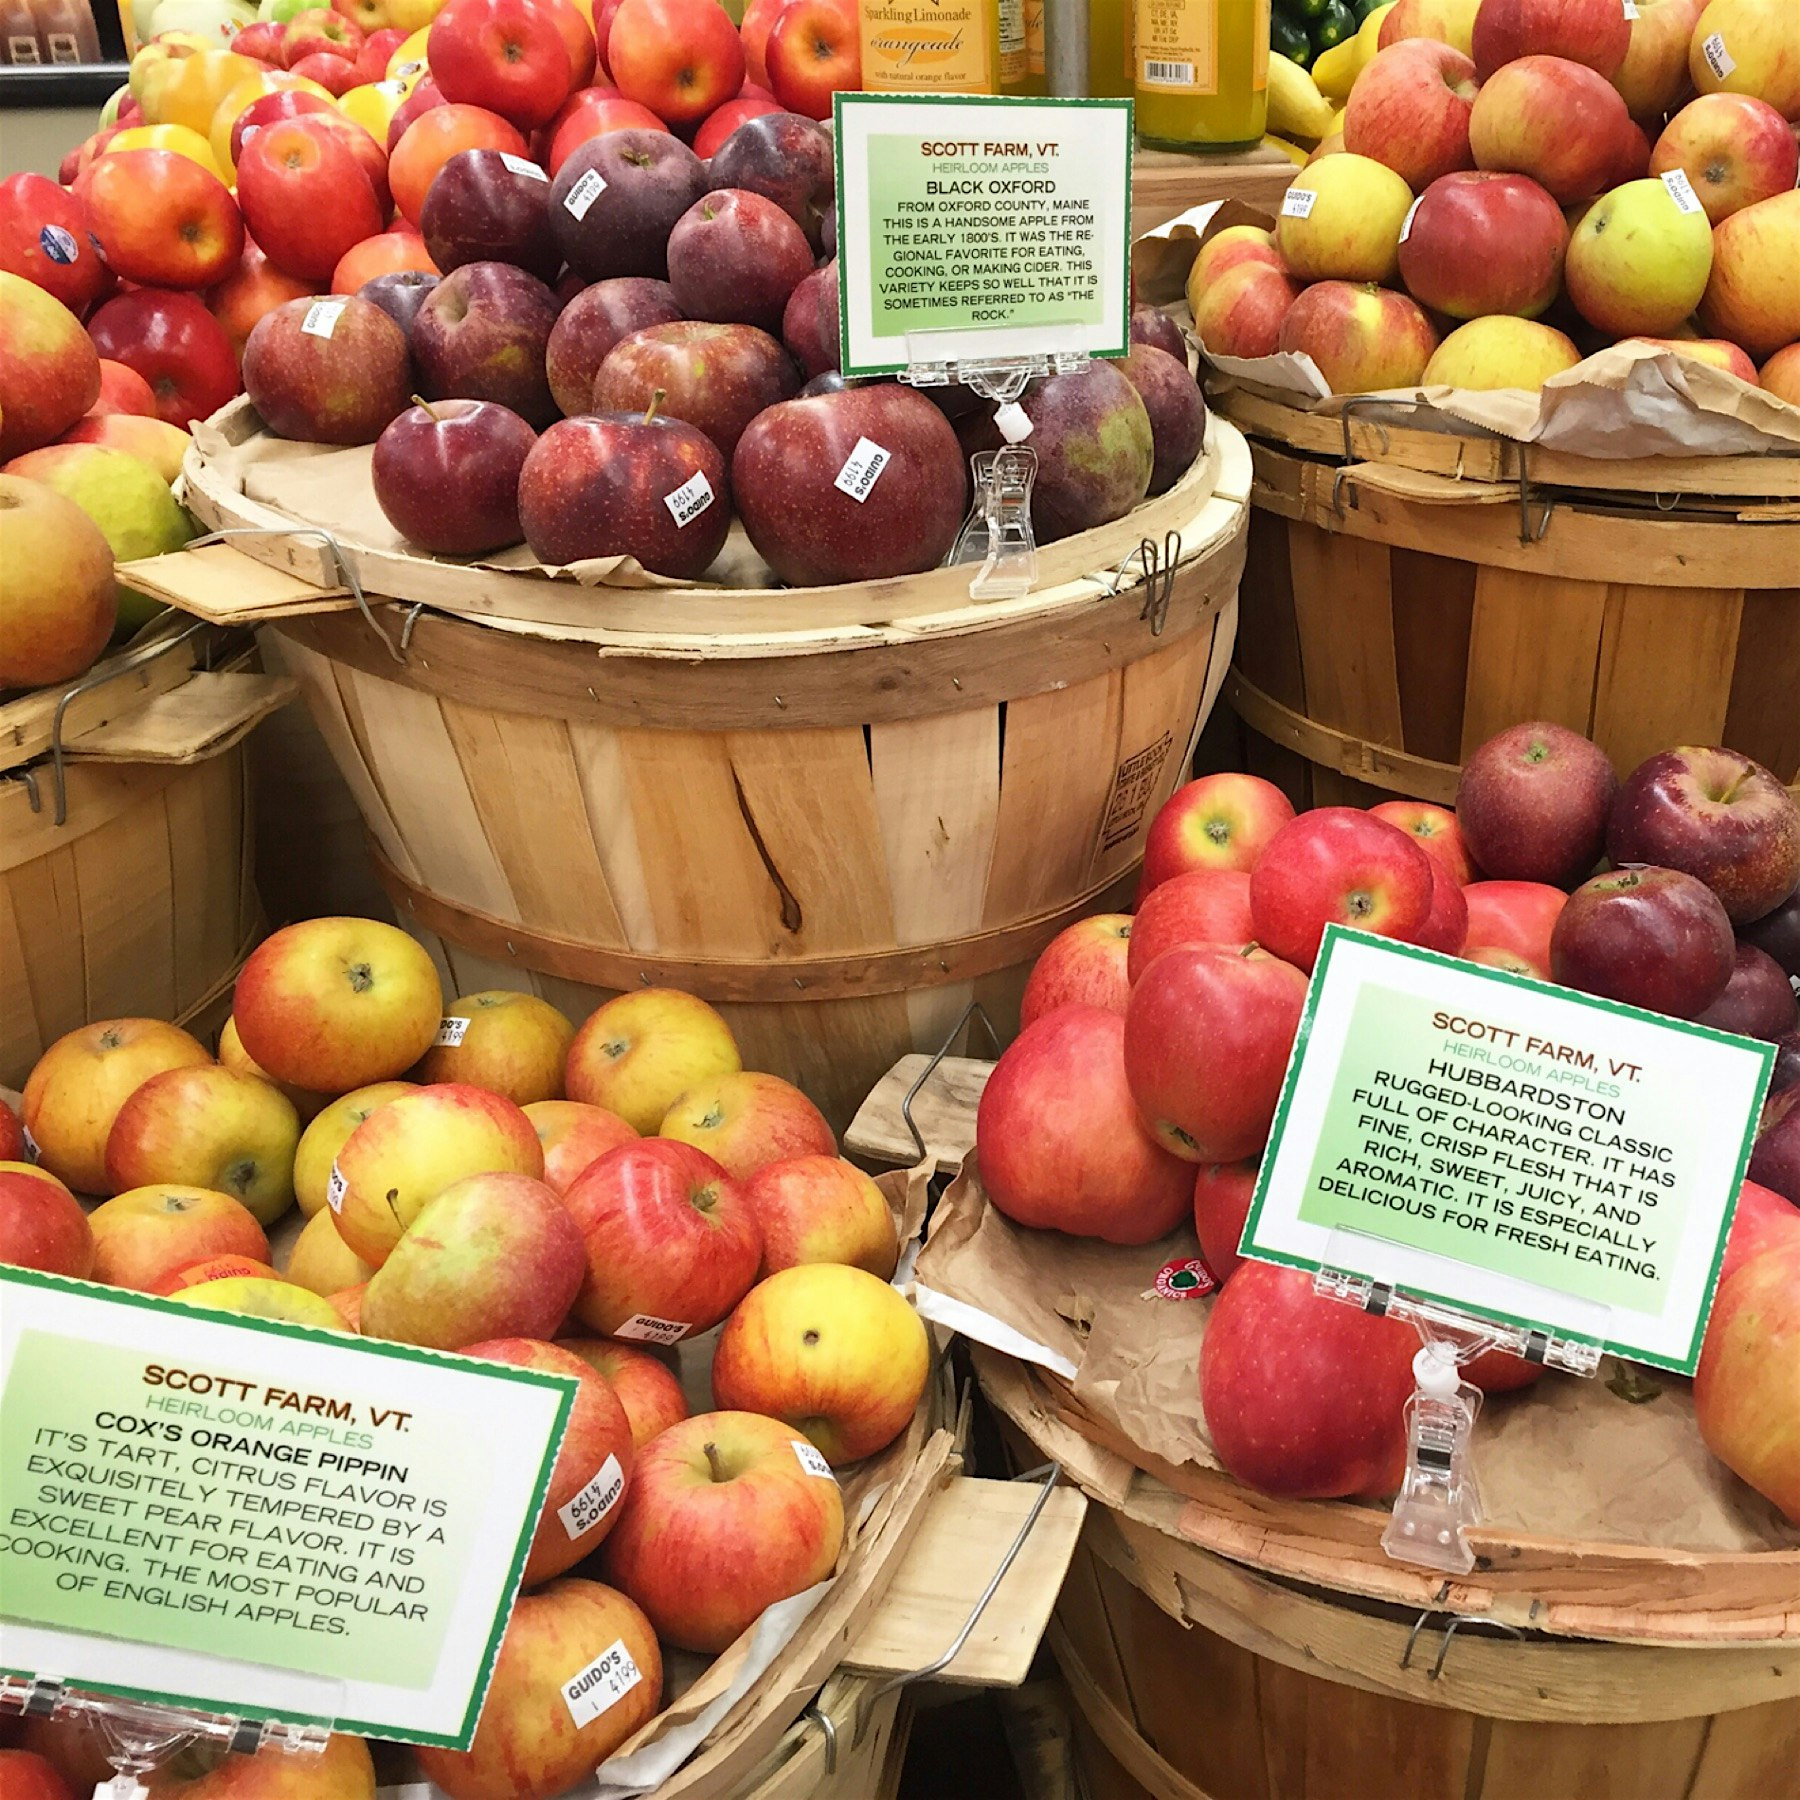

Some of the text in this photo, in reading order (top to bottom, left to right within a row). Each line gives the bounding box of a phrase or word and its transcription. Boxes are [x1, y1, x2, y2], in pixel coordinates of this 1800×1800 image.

[864, 6, 971, 24] Sparkling Limonade
[870, 27, 964, 69] orangeade
[1706, 44, 1724, 78] GUIDO'S
[889, 71, 914, 81] natural
[915, 74, 941, 83] orange
[944, 71, 967, 81] flavor
[921, 142, 1059, 158] SCOTT FARM, VT.
[933, 163, 1049, 173] HEIRLOOM APPLES
[568, 174, 594, 205] GUIDO'S
[898, 200, 1090, 212] FROM OXFORD COUNTY, MAINE
[927, 180, 1056, 195] BLACK OXFORD
[1287, 191, 1312, 202] GUIDO'S
[1667, 177, 1689, 211] GUIDO'S
[883, 215, 1094, 229] THIS IS A HANDSOME APPLE FROM
[883, 234, 910, 245] THE
[913, 234, 956, 245] EARLY
[1006, 231, 1017, 242] IT
[1019, 231, 1046, 242] WAS
[1049, 230, 1073, 241] THE
[1076, 229, 1094, 241] RE-
[885, 260, 1093, 278] COOKING, OR MAKING CIDER. THIS
[893, 245, 1085, 262] GIONAL FAVORITE FOR EATING,
[879, 275, 1097, 294] VARIETY KEEPS SO WELL THAT IT IS
[884, 296, 958, 310] SOMETIMES
[961, 293, 1025, 306] REFERRED
[1028, 292, 1045, 303] TO
[1048, 291, 1064, 302] AS
[843, 460, 861, 486] 4199
[855, 454, 884, 495] GUIDO'S
[673, 487, 694, 507] 4199
[679, 492, 711, 522] GUIDO'S
[1432, 1012, 1643, 1083] SCOTT FARM, VT.
[1443, 1039, 1620, 1098] HEIRLOOM APPLES
[1428, 1058, 1626, 1126] HUBBARDSTON
[1374, 1070, 1673, 1163] RUGGED-LOOKING CLASSIC
[1352, 1088, 1676, 1188] FULL OF CHARACTER. IT HAS
[1358, 1114, 1658, 1207] FINE, CRISP FLESH THAT IS
[1363, 1140, 1641, 1225] RICH, SWEET, JUICY, AND
[1336, 1158, 1657, 1253] AROMATIC. IT IS ESPECIALLY
[1318, 1176, 1660, 1281] DELICIOUS FOR FRESH EATING.
[635, 1317, 684, 1333] GUIDO'S
[142, 1364, 413, 1432] SCOTT FARM, VT.
[146, 1395, 374, 1449] HEIRLOOM APPLES
[95, 1411, 409, 1483] COX'S ORANGE PIPPIN
[35, 1428, 447, 1517] IT'S TART, CITRUS FLAVOR IS
[27, 1454, 445, 1545] EXQUISITELY TEMPERED BY A
[571, 1481, 601, 1518] 4199
[576, 1477, 623, 1531] GUIDO'S
[38, 1485, 415, 1565] SWEET PEAR FLAVOR. IT IS
[10, 1508, 425, 1594] EXCELLENT FOR EATING AND
[56, 1573, 350, 1636] OF ENGLISH APPLES.
[143, 1558, 201, 1584] THE
[206, 1570, 290, 1597] MOST
[295, 1585, 428, 1622] POPULAR
[567, 1650, 622, 1701] GUIDO'S
[609, 1660, 637, 1695] 4199
